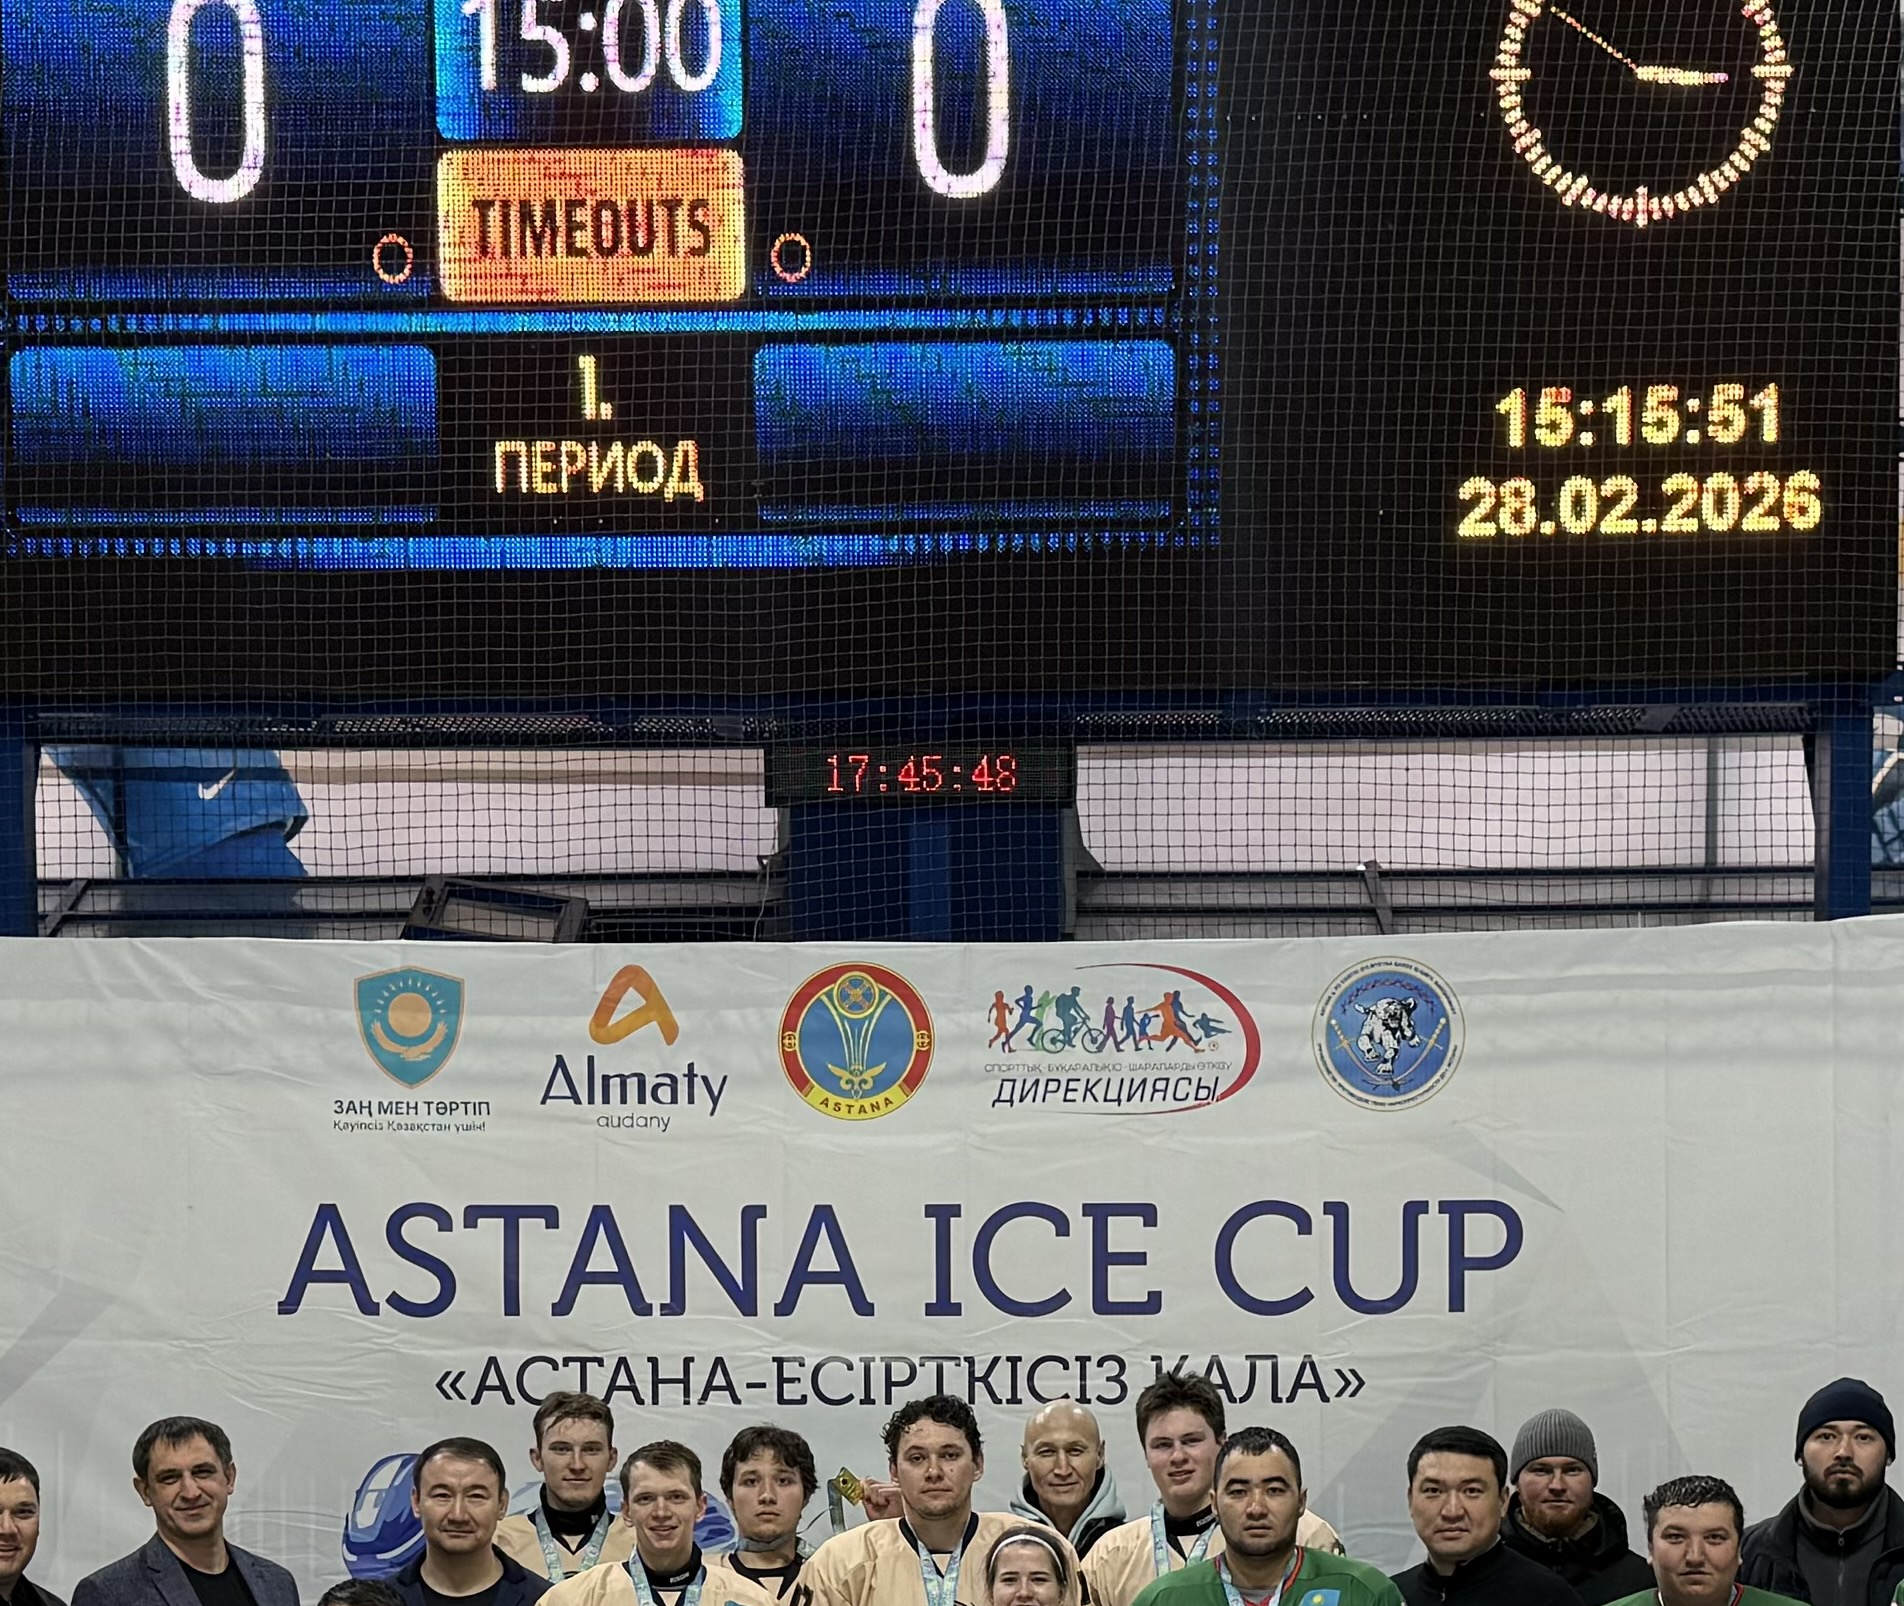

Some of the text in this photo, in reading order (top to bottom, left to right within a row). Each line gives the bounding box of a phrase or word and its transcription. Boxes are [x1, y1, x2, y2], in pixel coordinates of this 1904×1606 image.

[462, 0, 723, 93] 15:00
[167, 0, 266, 203] 0
[912, 0, 1009, 198] 0
[473, 198, 711, 259] TIMEOUTS
[1495, 382, 1781, 448] 15:15:51
[495, 440, 704, 503] ПЕРИОД
[1457, 469, 1822, 538] 28.02.2026
[827, 754, 1016, 792] 17:45:48
[333, 1099, 491, 1118] ЗАҢ МЕН ТӘРТІП
[540, 1053, 728, 1117] Almaty
[819, 1094, 895, 1115] ASTANA
[991, 1076, 1219, 1108] ДИРЕКЦИЯСЫ
[597, 1112, 671, 1133] audany
[277, 1200, 1524, 1317] ASTANA ICE CUP
